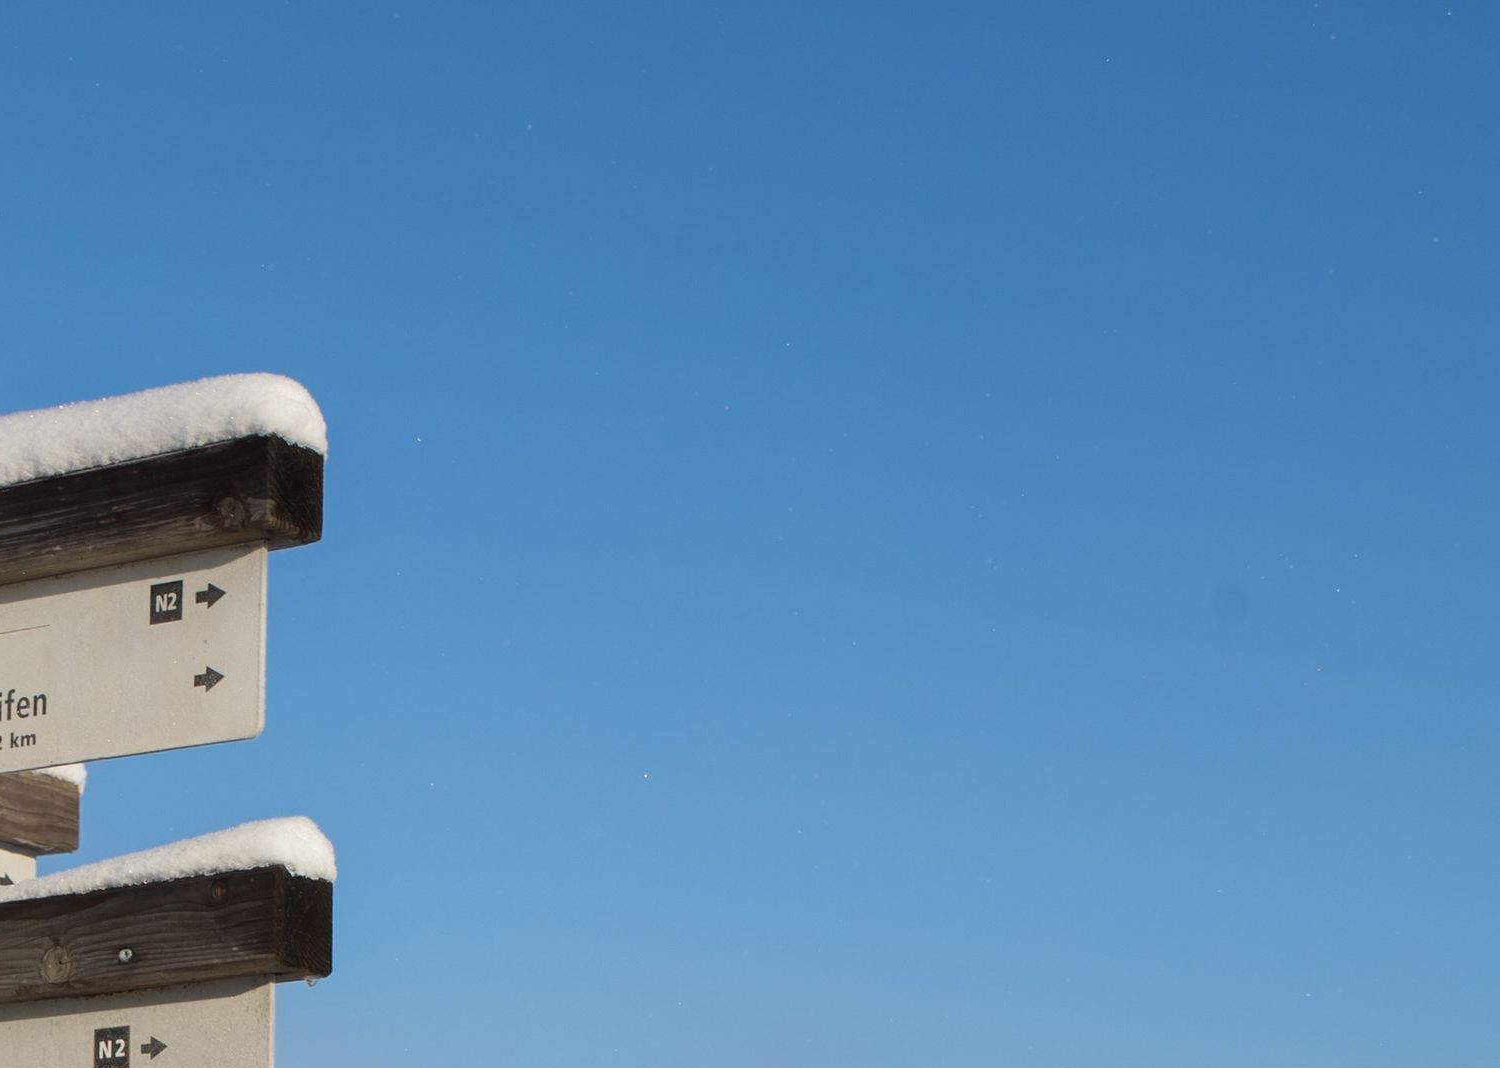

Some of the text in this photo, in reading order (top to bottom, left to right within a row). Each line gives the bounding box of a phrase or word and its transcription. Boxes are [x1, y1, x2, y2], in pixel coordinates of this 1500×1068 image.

[155, 592, 177, 613] N2
[10, 731, 36, 749] km
[99, 1038, 126, 1059] N2
